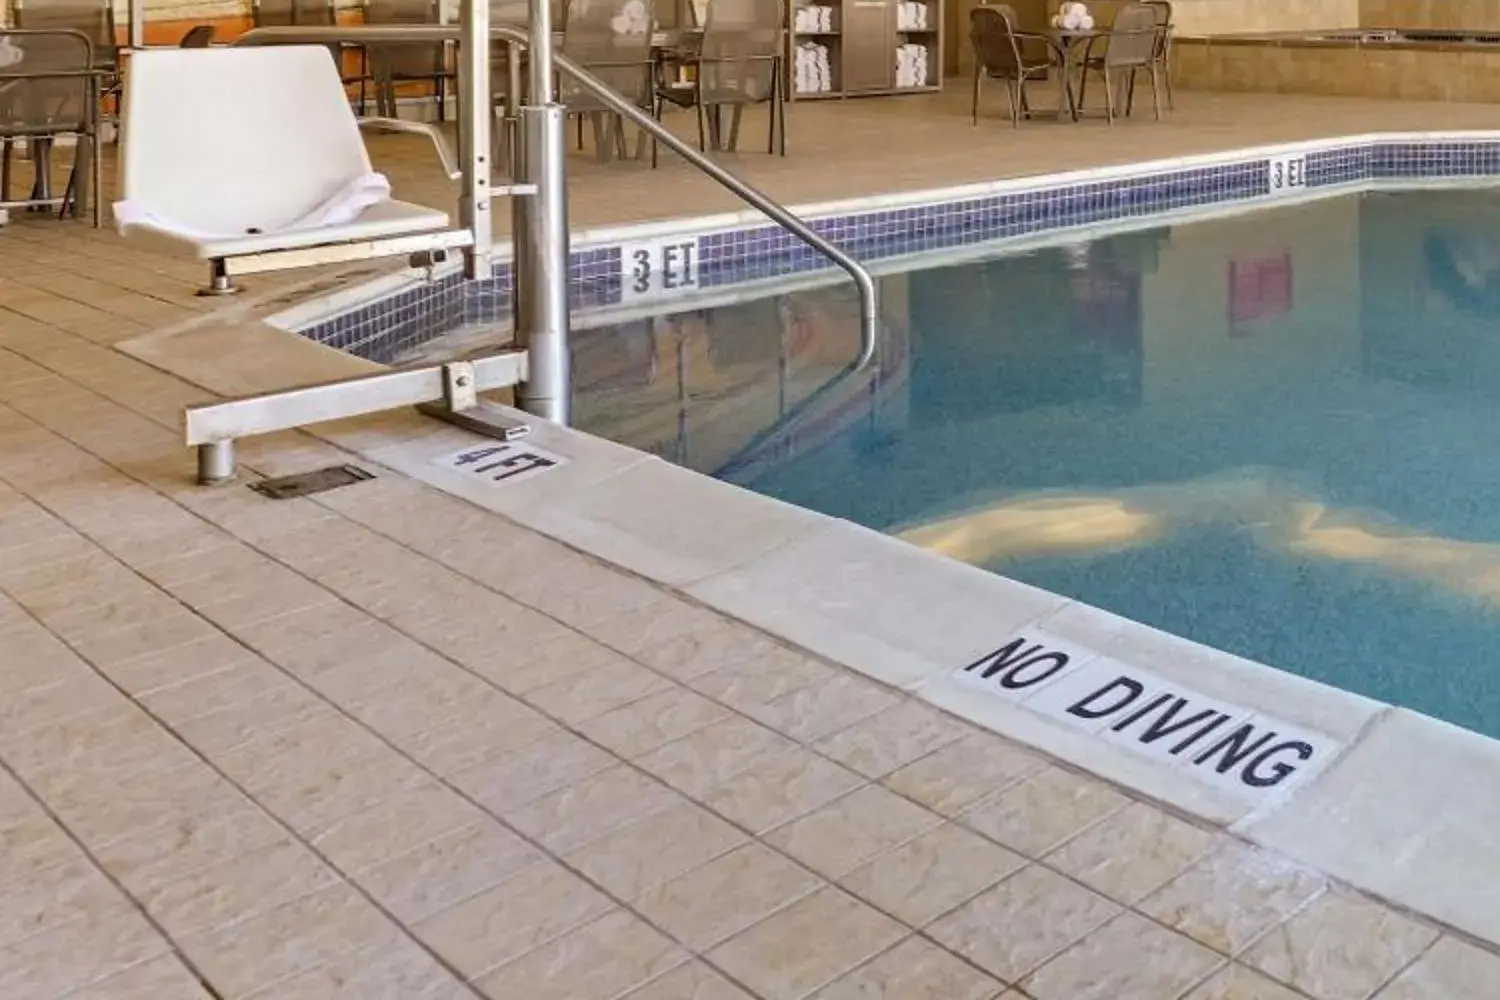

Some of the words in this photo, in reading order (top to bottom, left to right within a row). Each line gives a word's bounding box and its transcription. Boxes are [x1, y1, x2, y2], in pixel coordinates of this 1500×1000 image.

[453, 445, 511, 466] 4
[475, 452, 557, 481] FT
[963, 637, 1069, 690] NO
[1066, 675, 1314, 788] DIVING
